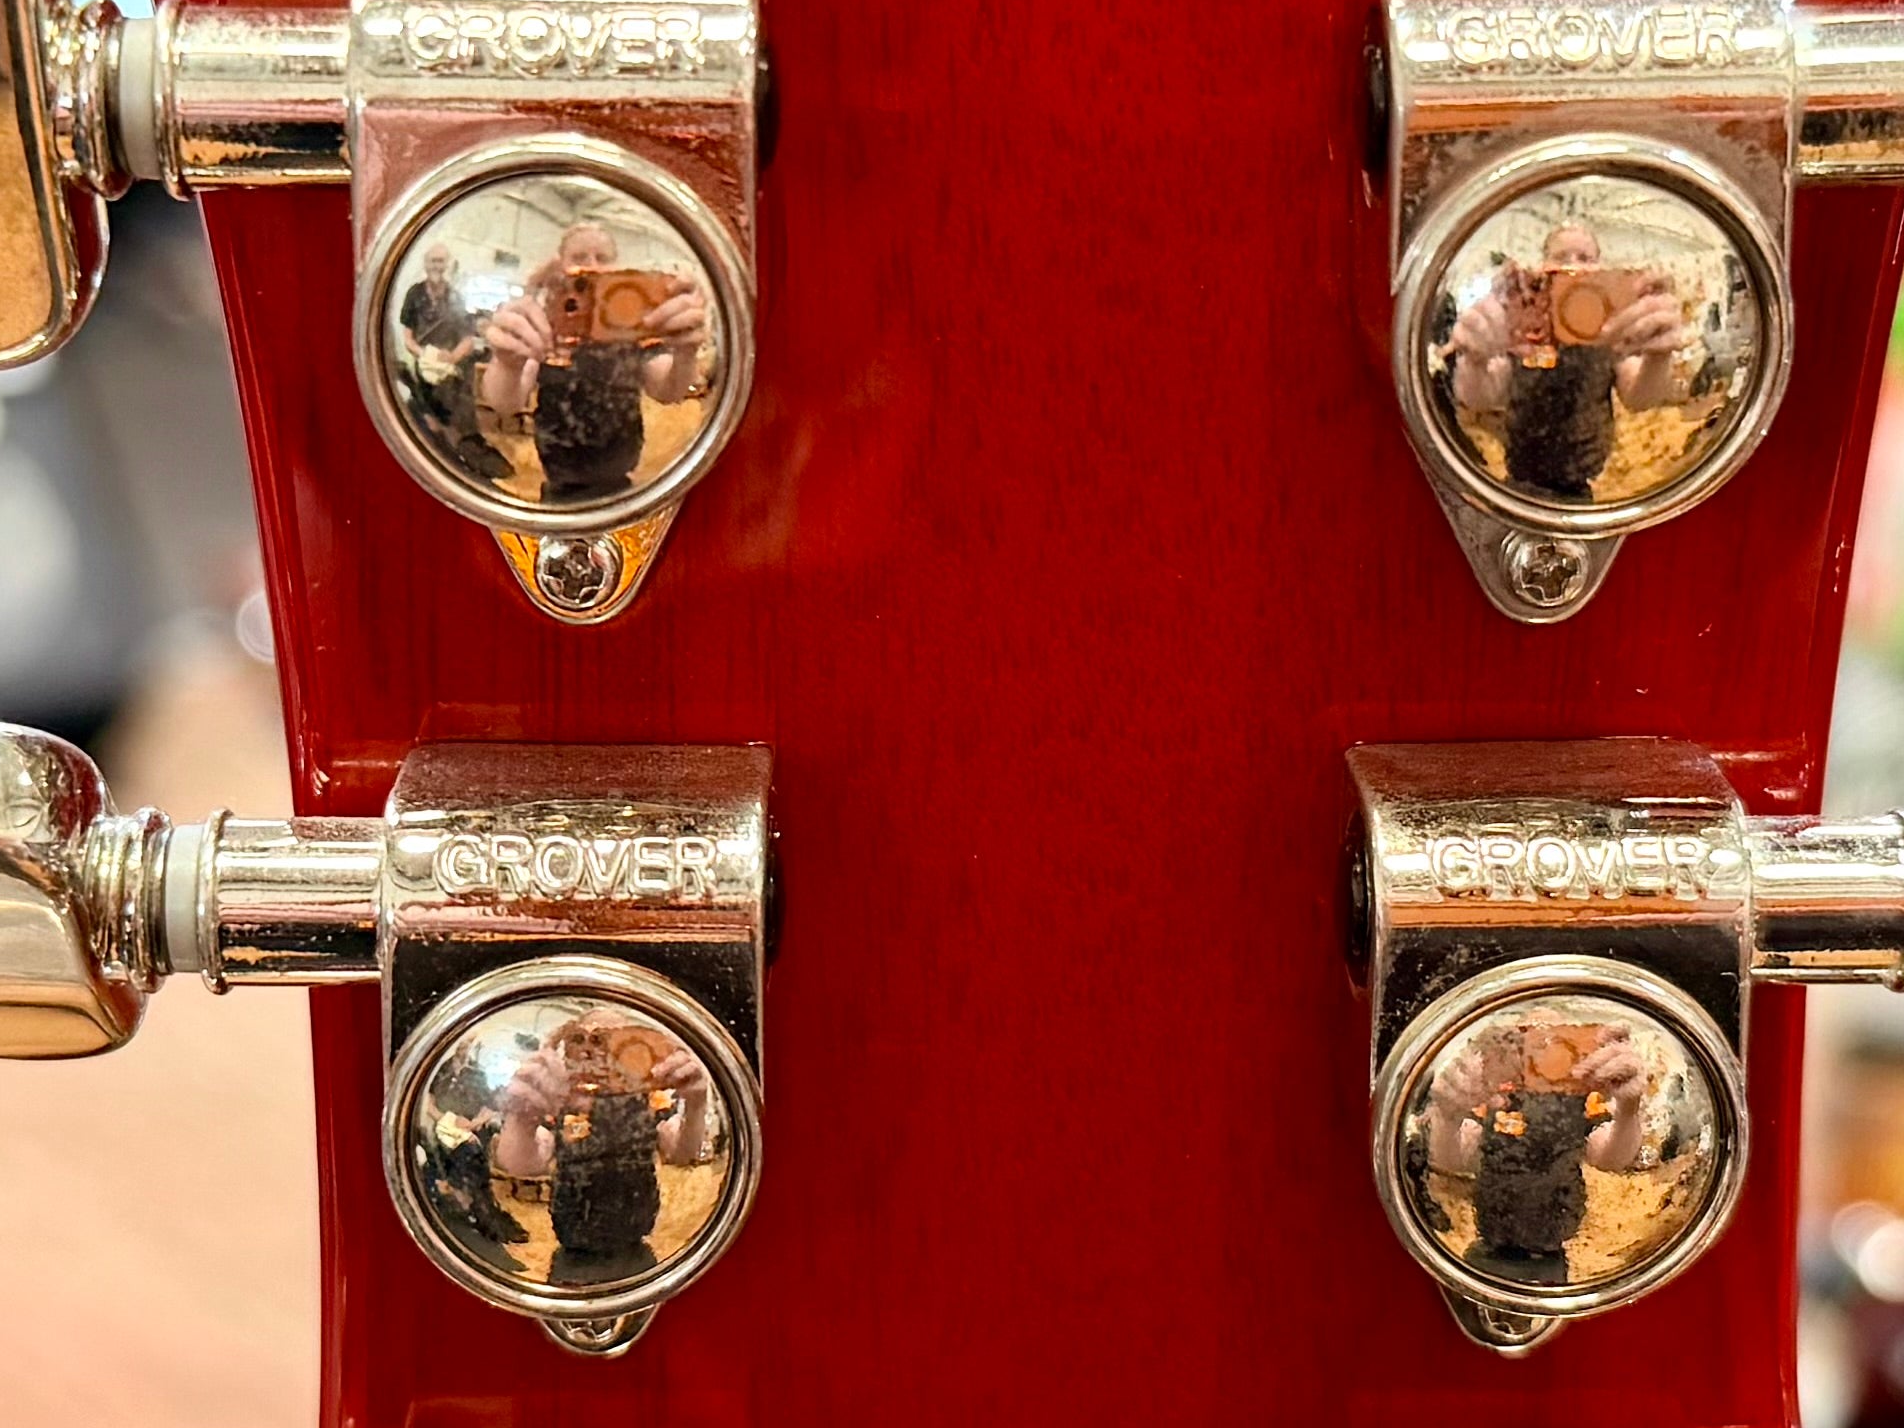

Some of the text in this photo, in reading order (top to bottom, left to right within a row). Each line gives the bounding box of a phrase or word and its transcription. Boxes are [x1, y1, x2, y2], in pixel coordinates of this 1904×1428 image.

[405, 6, 705, 75] GROVER
[1444, 6, 1738, 67] GROVER
[434, 834, 718, 898] GROVER
[1430, 834, 1710, 900] GROVER
